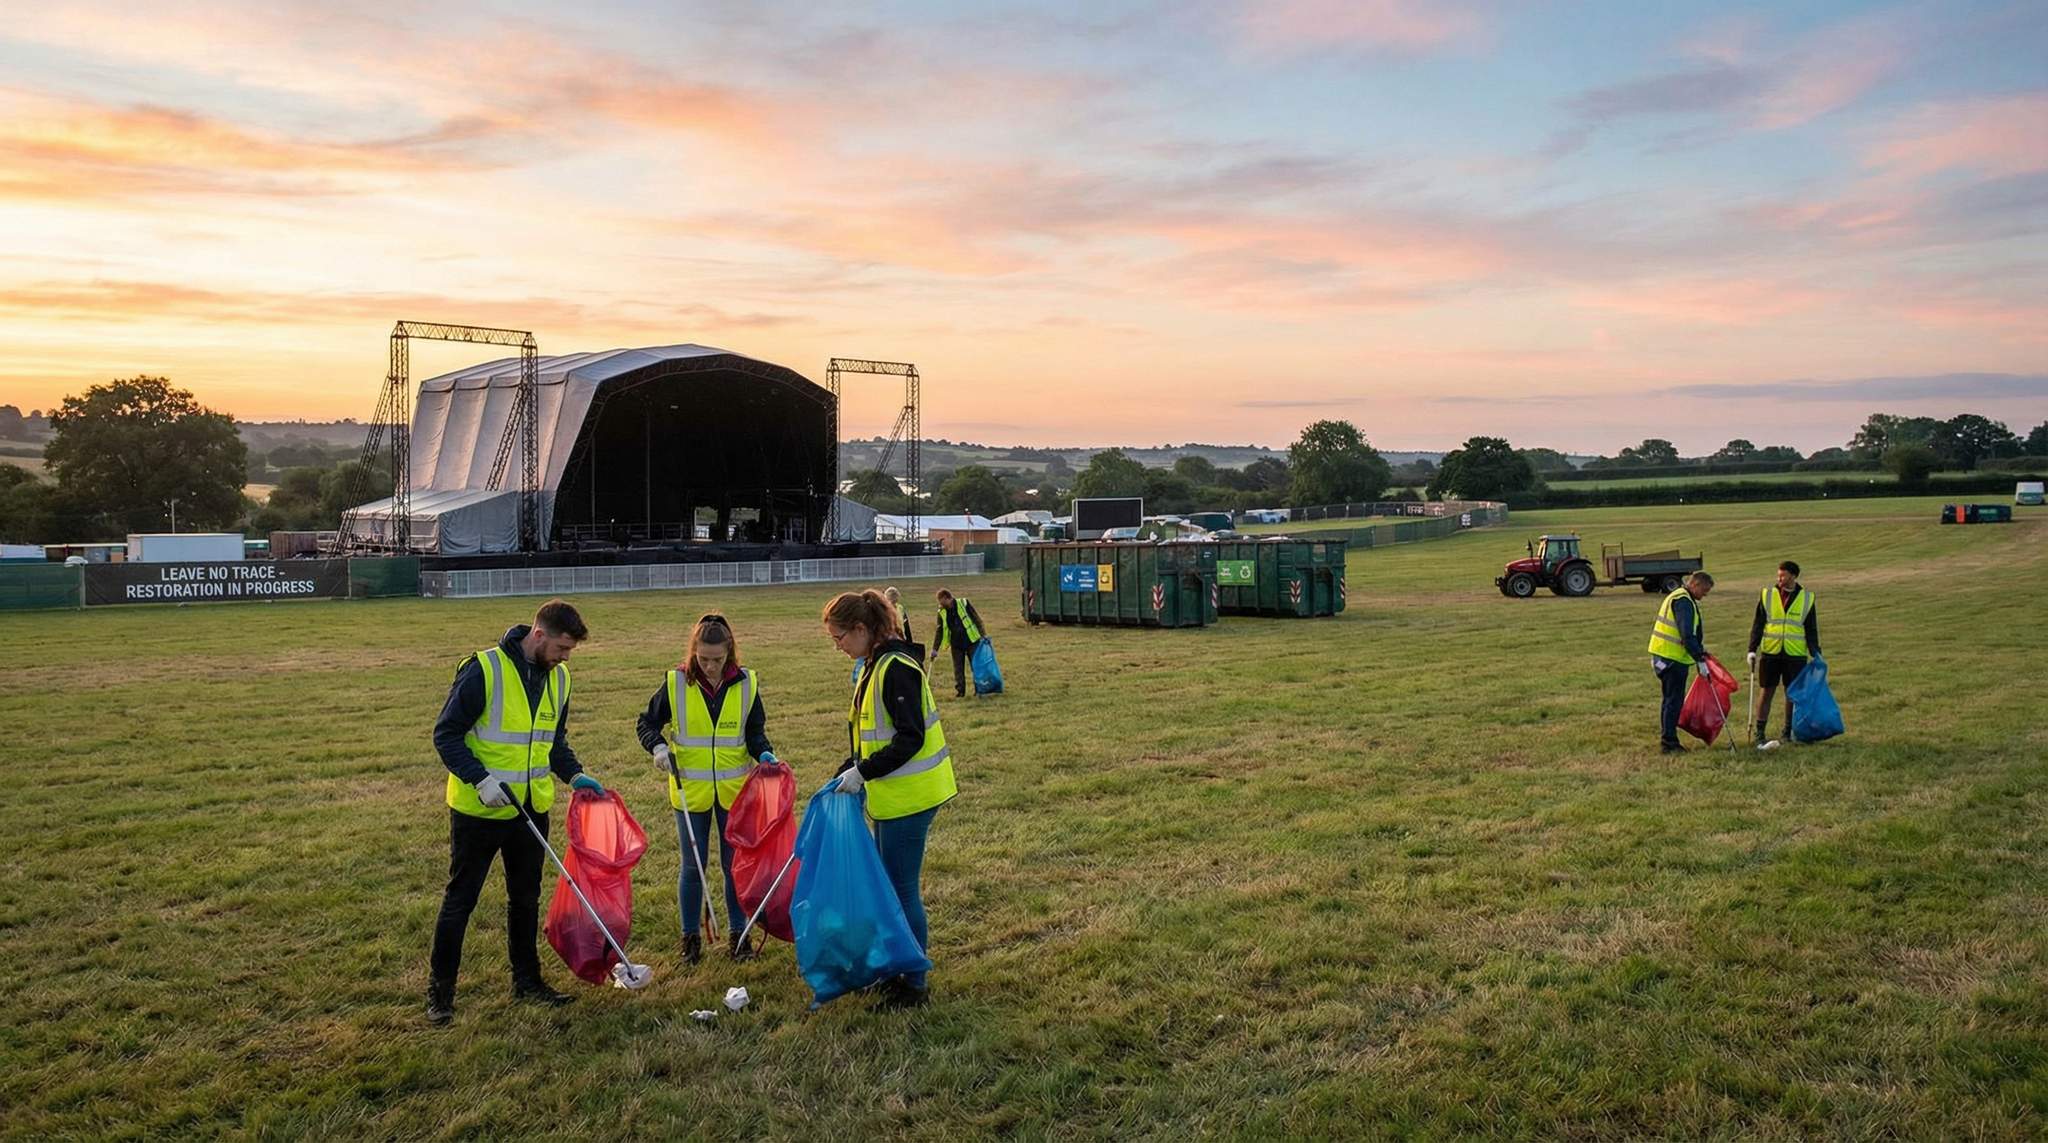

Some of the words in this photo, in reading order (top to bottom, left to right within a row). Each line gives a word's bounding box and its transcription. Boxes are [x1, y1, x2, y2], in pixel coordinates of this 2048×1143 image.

[161, 567, 205, 581] LEAVE
[209, 566, 228, 580] NO
[232, 566, 276, 580] TRACE
[126, 583, 223, 598] RESTORATION
[228, 582, 241, 596] IN
[245, 580, 315, 595] PROGRESS
